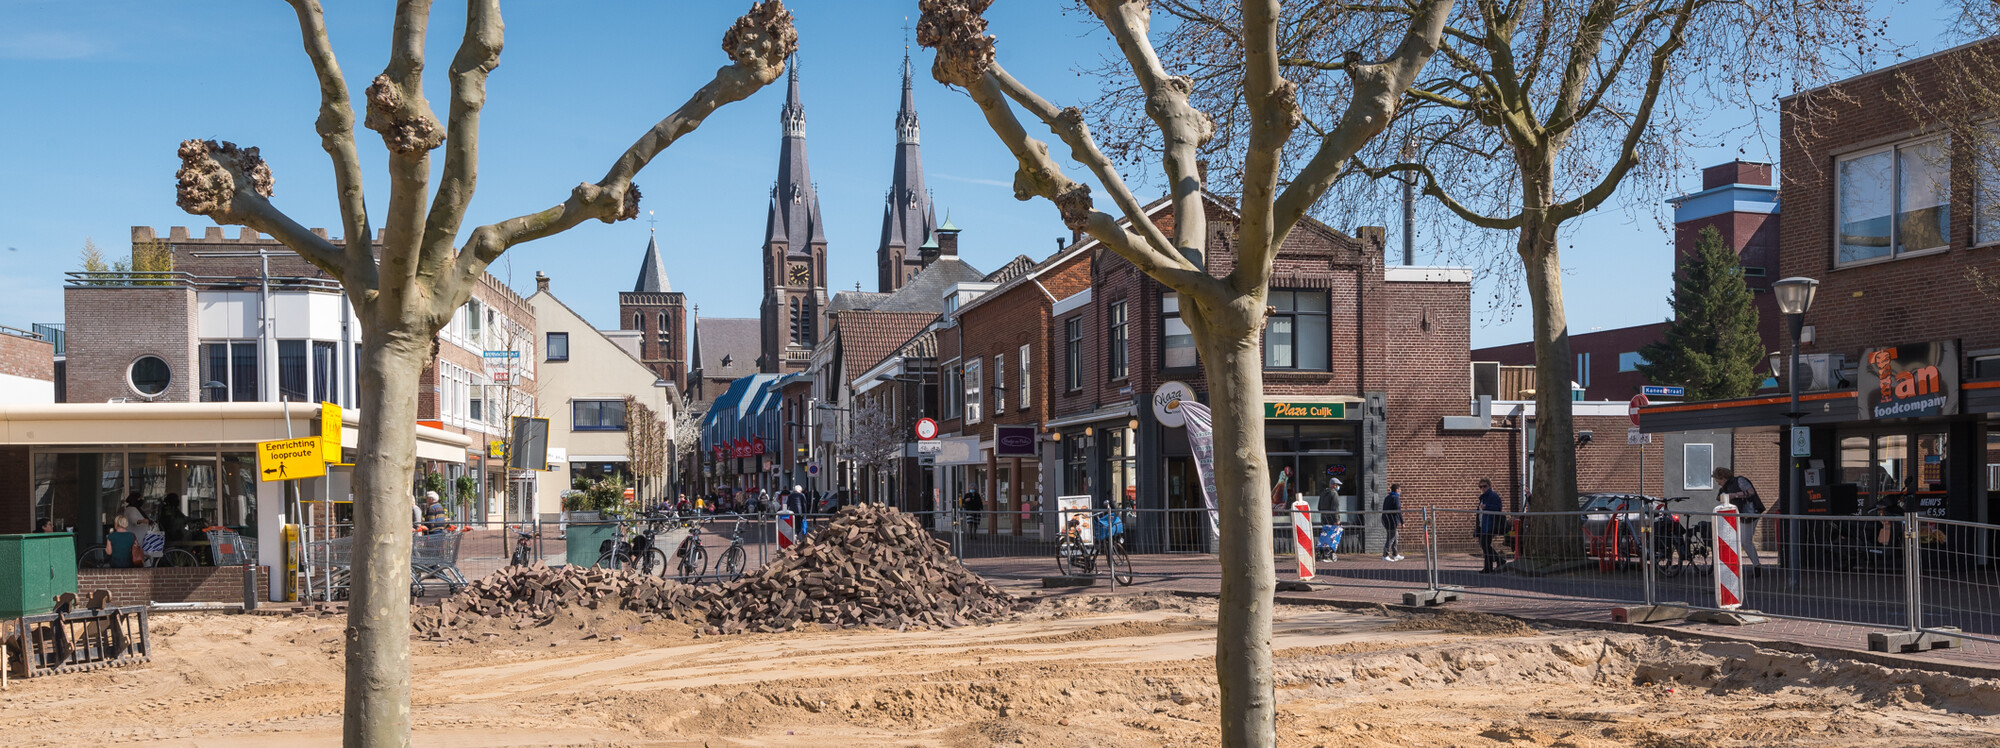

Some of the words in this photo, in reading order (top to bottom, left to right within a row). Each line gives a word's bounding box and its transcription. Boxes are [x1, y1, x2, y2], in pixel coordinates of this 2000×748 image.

[1154, 389, 1183, 407] Plaza
[1273, 403, 1308, 418] Plaza
[1310, 406, 1333, 418] Cuijk
[1874, 396, 1947, 418] foodcompany
[265, 440, 315, 451] Eenrichting
[271, 449, 312, 460] looproute
[1920, 498, 1942, 507] MENU'S
[1927, 508, 1932, 516] €
[1932, 508, 1946, 517] 5,95
